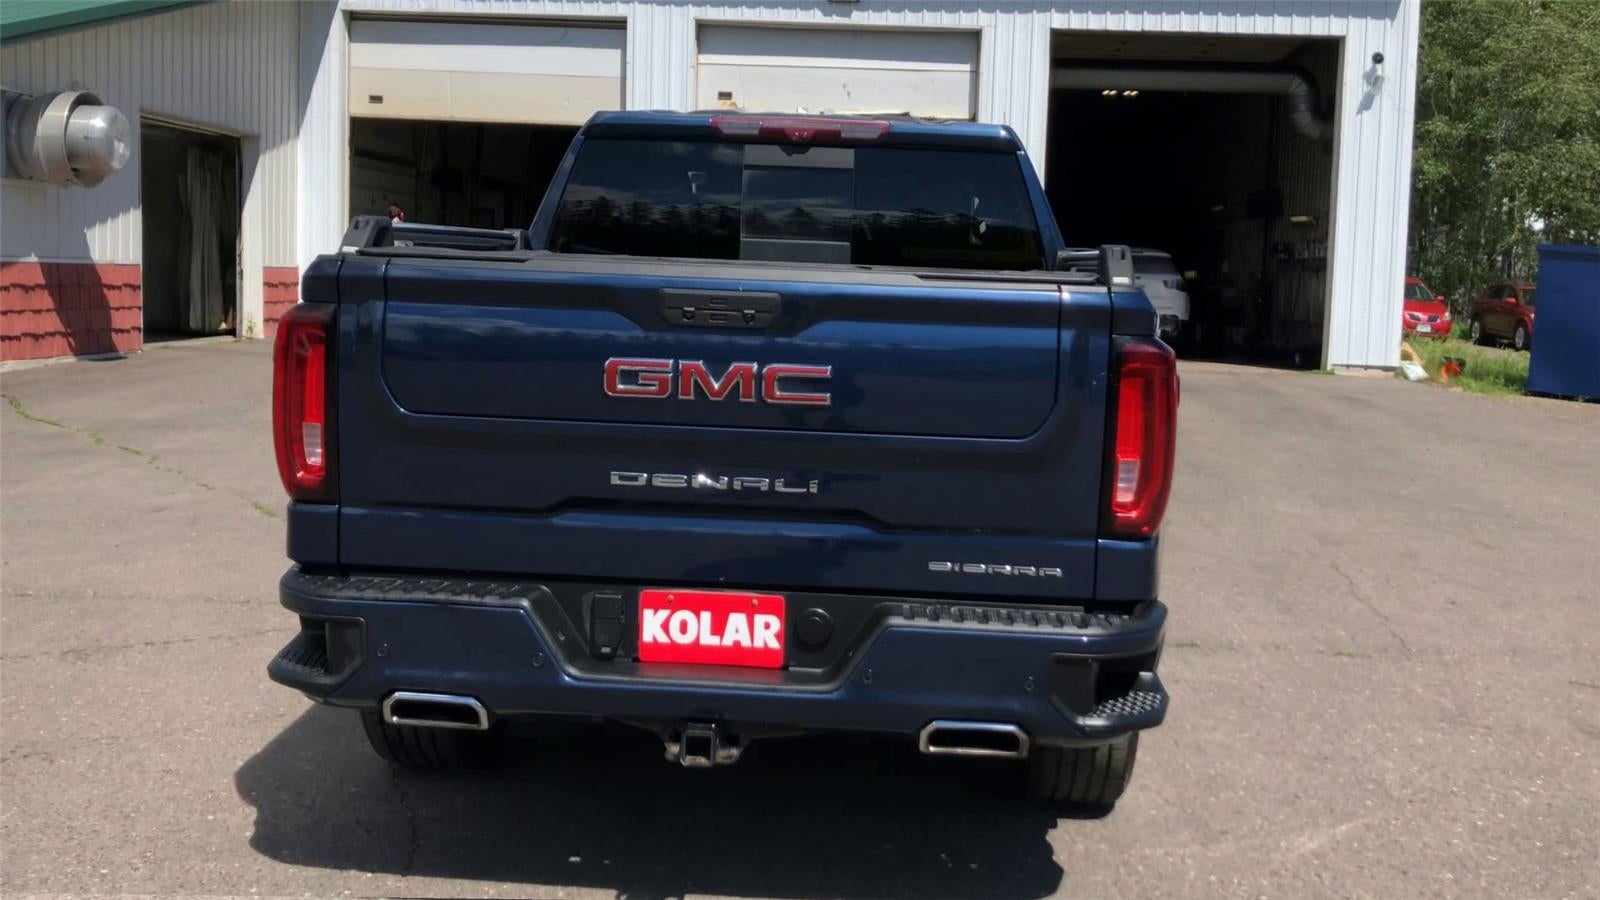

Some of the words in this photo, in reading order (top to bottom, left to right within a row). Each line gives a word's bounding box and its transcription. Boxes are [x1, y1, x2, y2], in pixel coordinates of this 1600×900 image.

[604, 357, 832, 405] GMC
[610, 471, 819, 494] DENALI
[928, 561, 1063, 578] SIERRA
[642, 608, 781, 649] KOLAR
